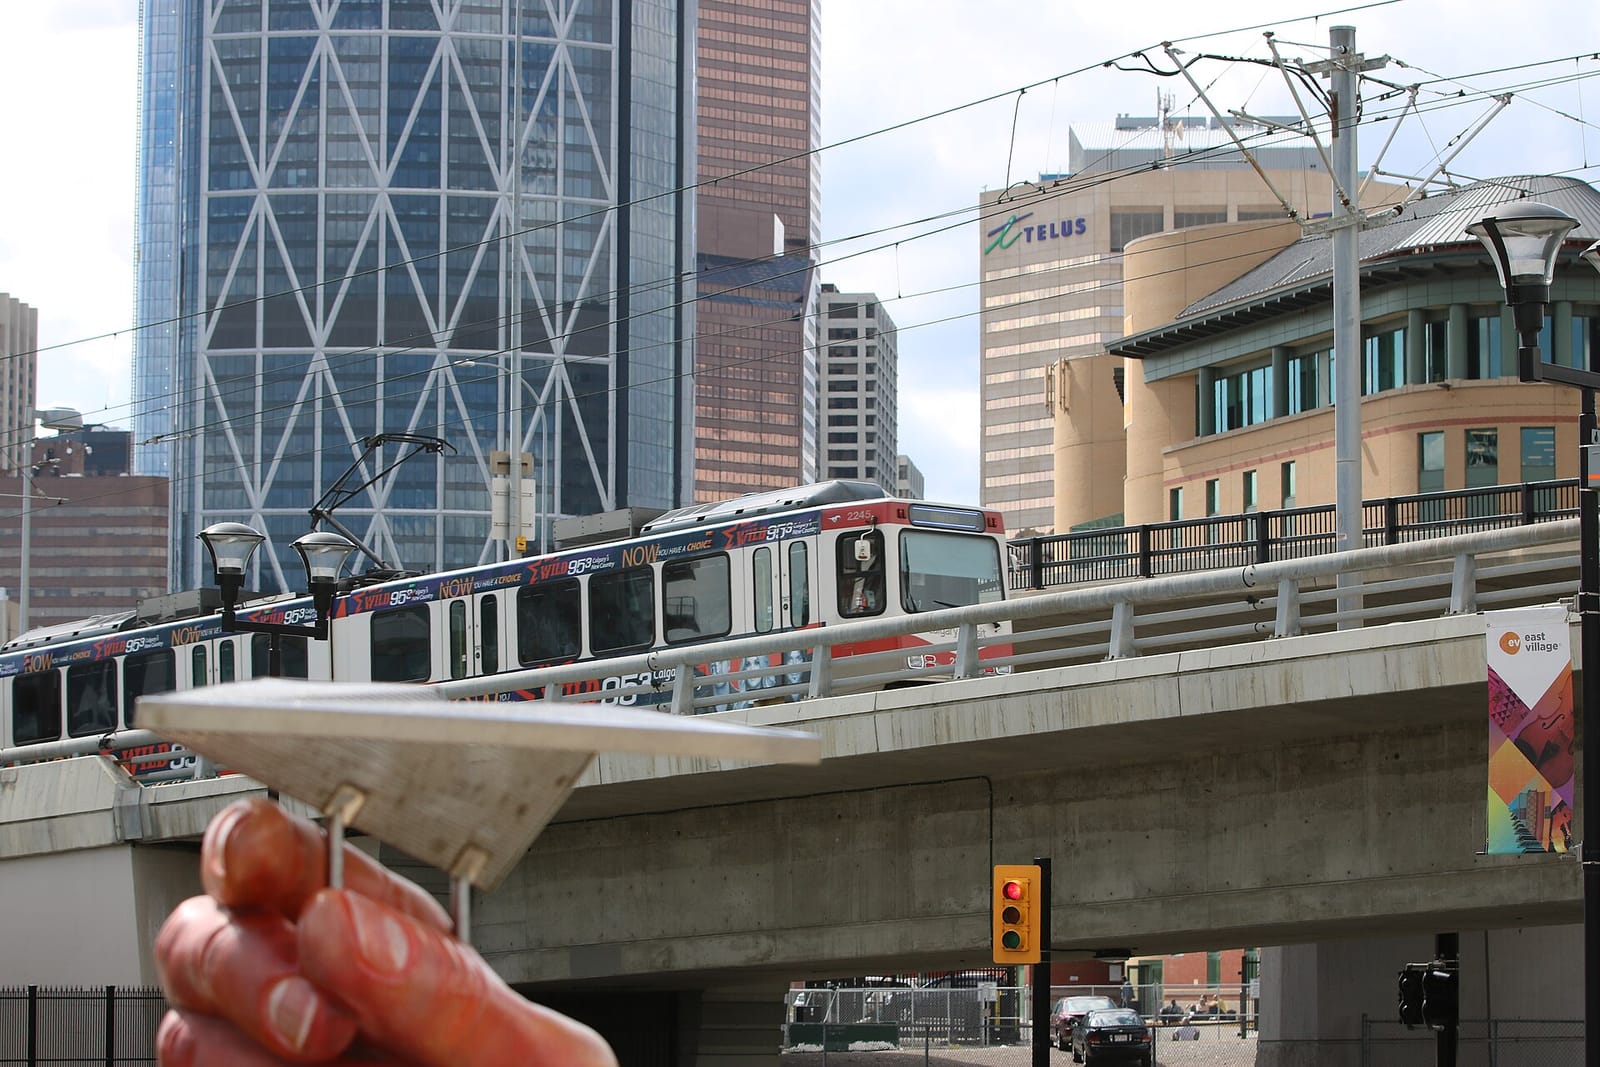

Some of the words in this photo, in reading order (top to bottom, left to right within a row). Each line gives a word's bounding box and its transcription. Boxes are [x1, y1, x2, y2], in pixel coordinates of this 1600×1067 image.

[1024, 218, 1086, 242] TELUS
[847, 510, 871, 521] 2245
[622, 544, 660, 568] NOW
[540, 561, 568, 580] WILD
[568, 558, 592, 575] 953
[439, 576, 474, 600] NOW
[498, 573, 522, 584] CHOICE
[364, 592, 390, 609] WILD
[1524, 632, 1546, 642] east
[104, 640, 126, 656] WILD
[1526, 642, 1558, 652] village
